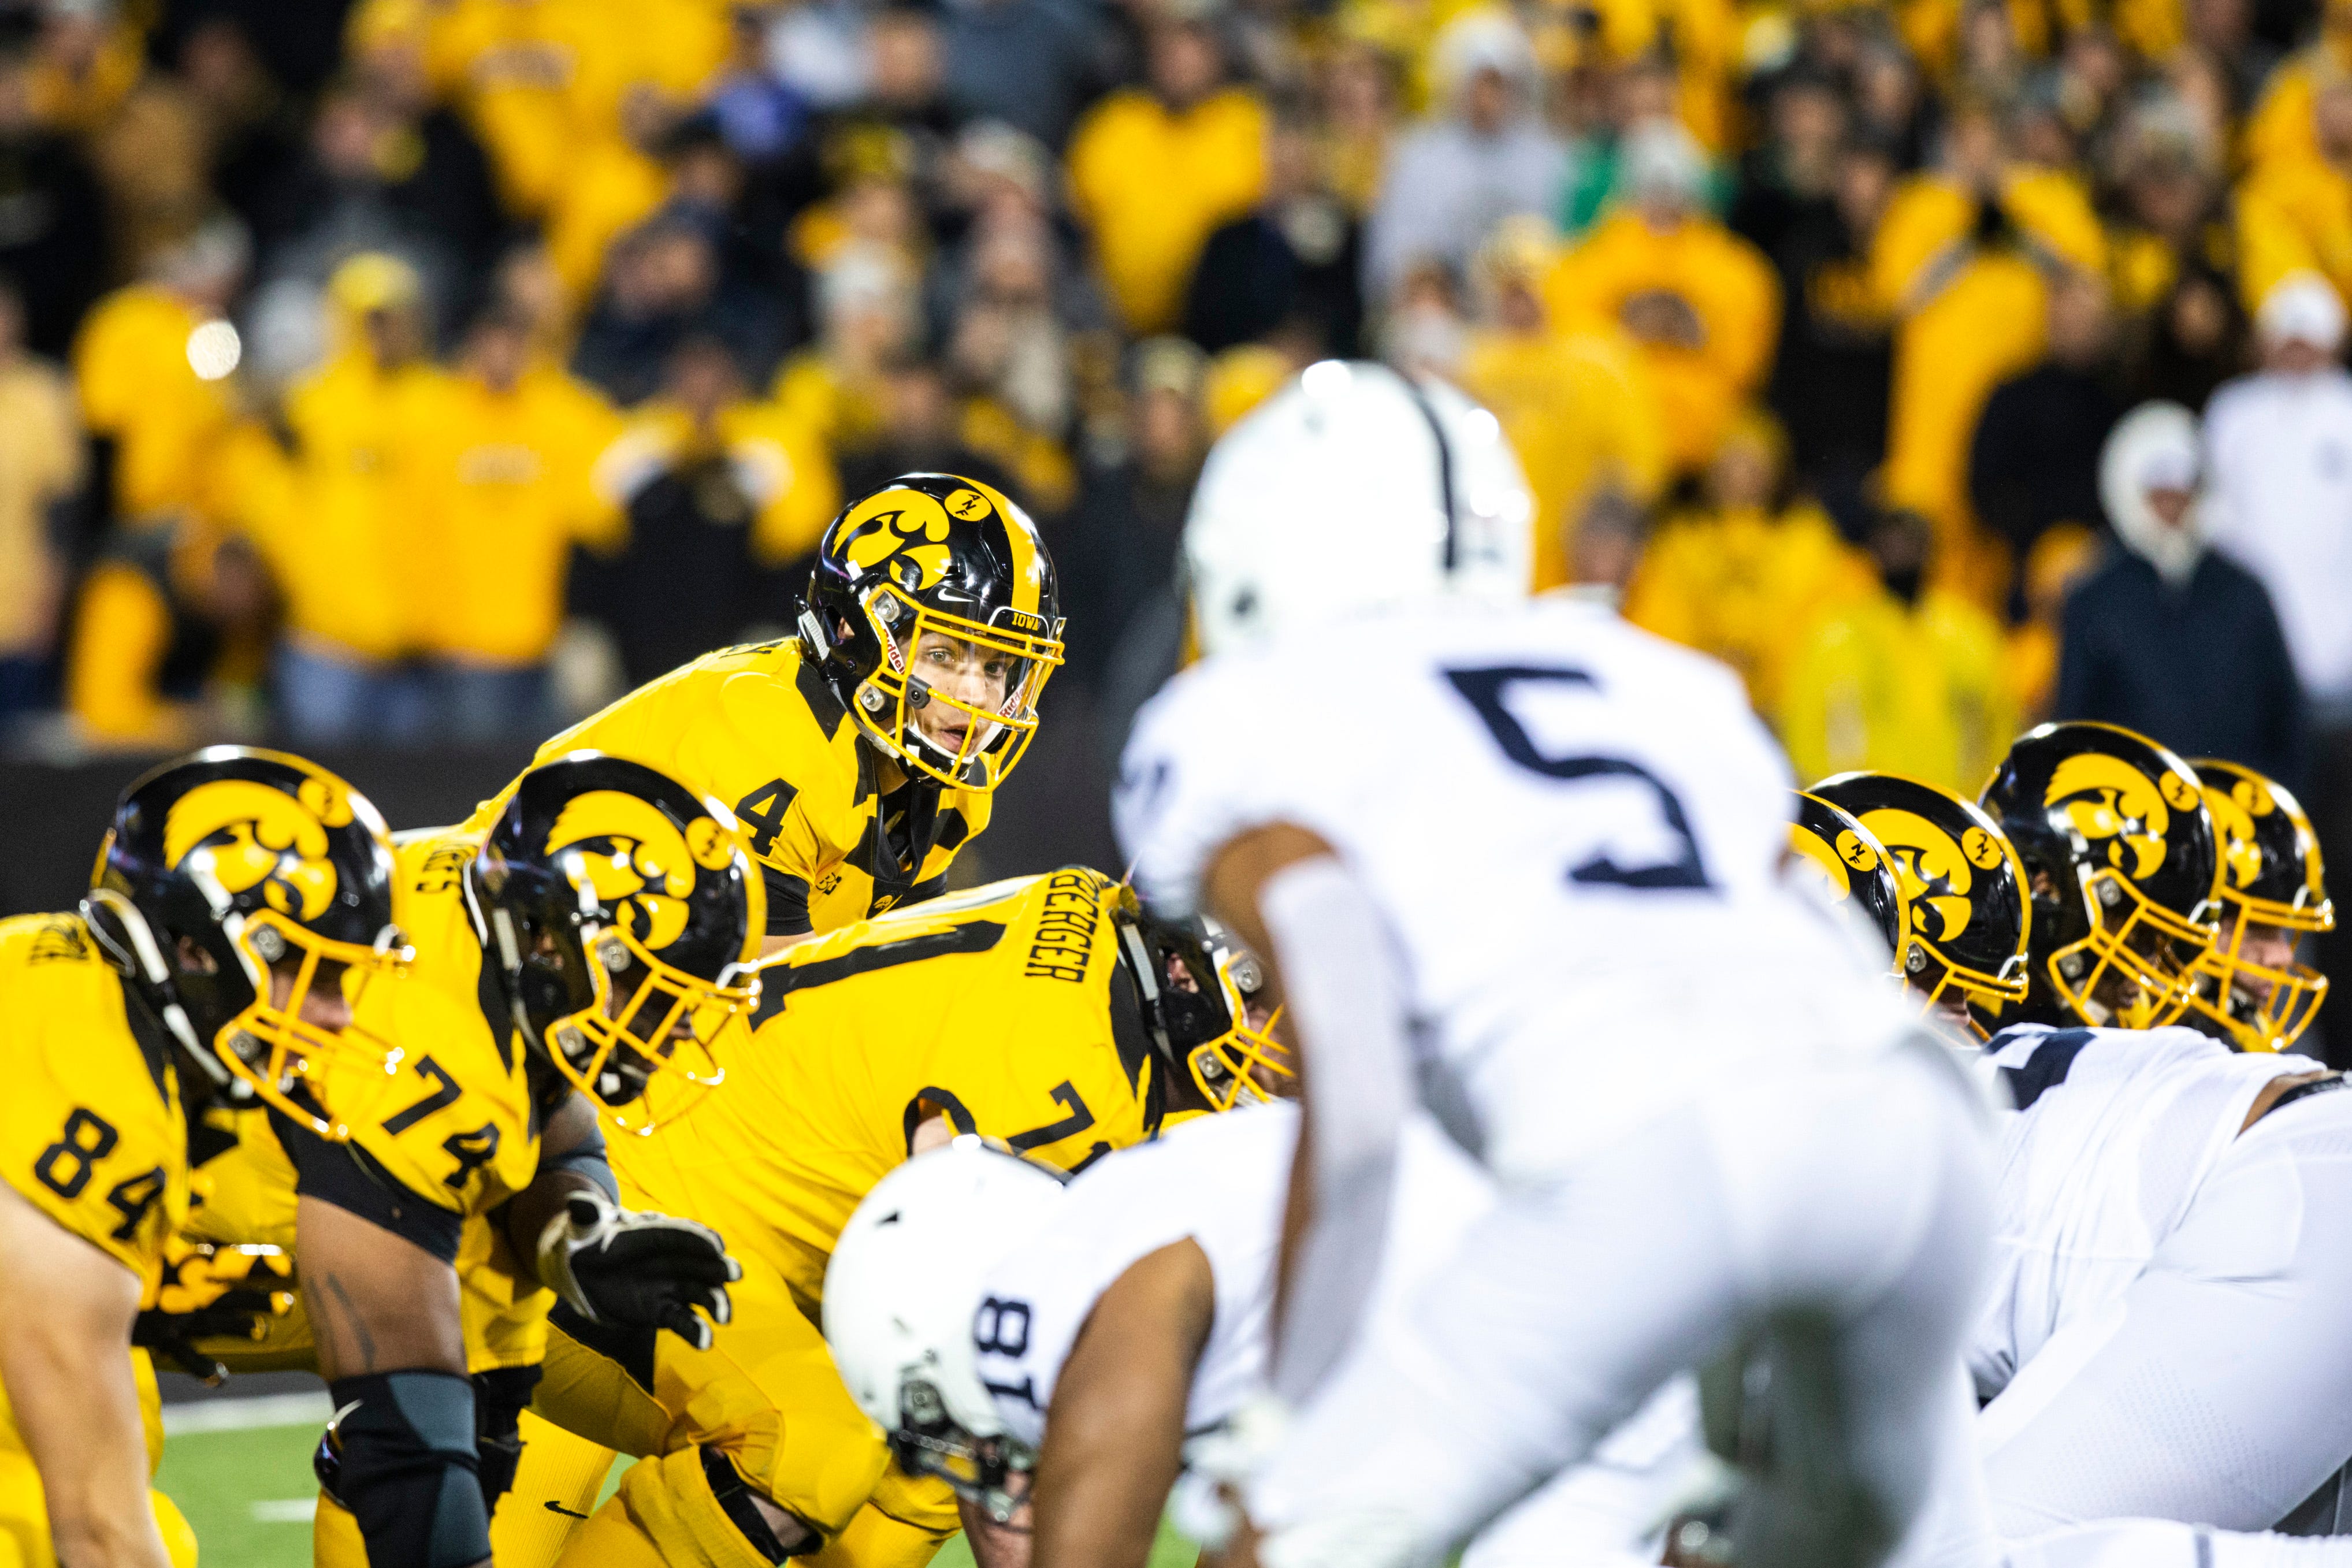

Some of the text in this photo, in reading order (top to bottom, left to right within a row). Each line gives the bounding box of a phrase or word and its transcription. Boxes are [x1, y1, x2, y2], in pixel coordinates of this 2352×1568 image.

[955, 494, 981, 516] ANF
[1012, 612, 1041, 631] IOWA
[734, 777, 800, 857] 4
[1443, 666, 1719, 890] 5
[1024, 870, 1109, 983] BERGER
[34, 1108, 166, 1240] 84
[381, 1055, 500, 1189] 74
[974, 1297, 1040, 1410] 81
